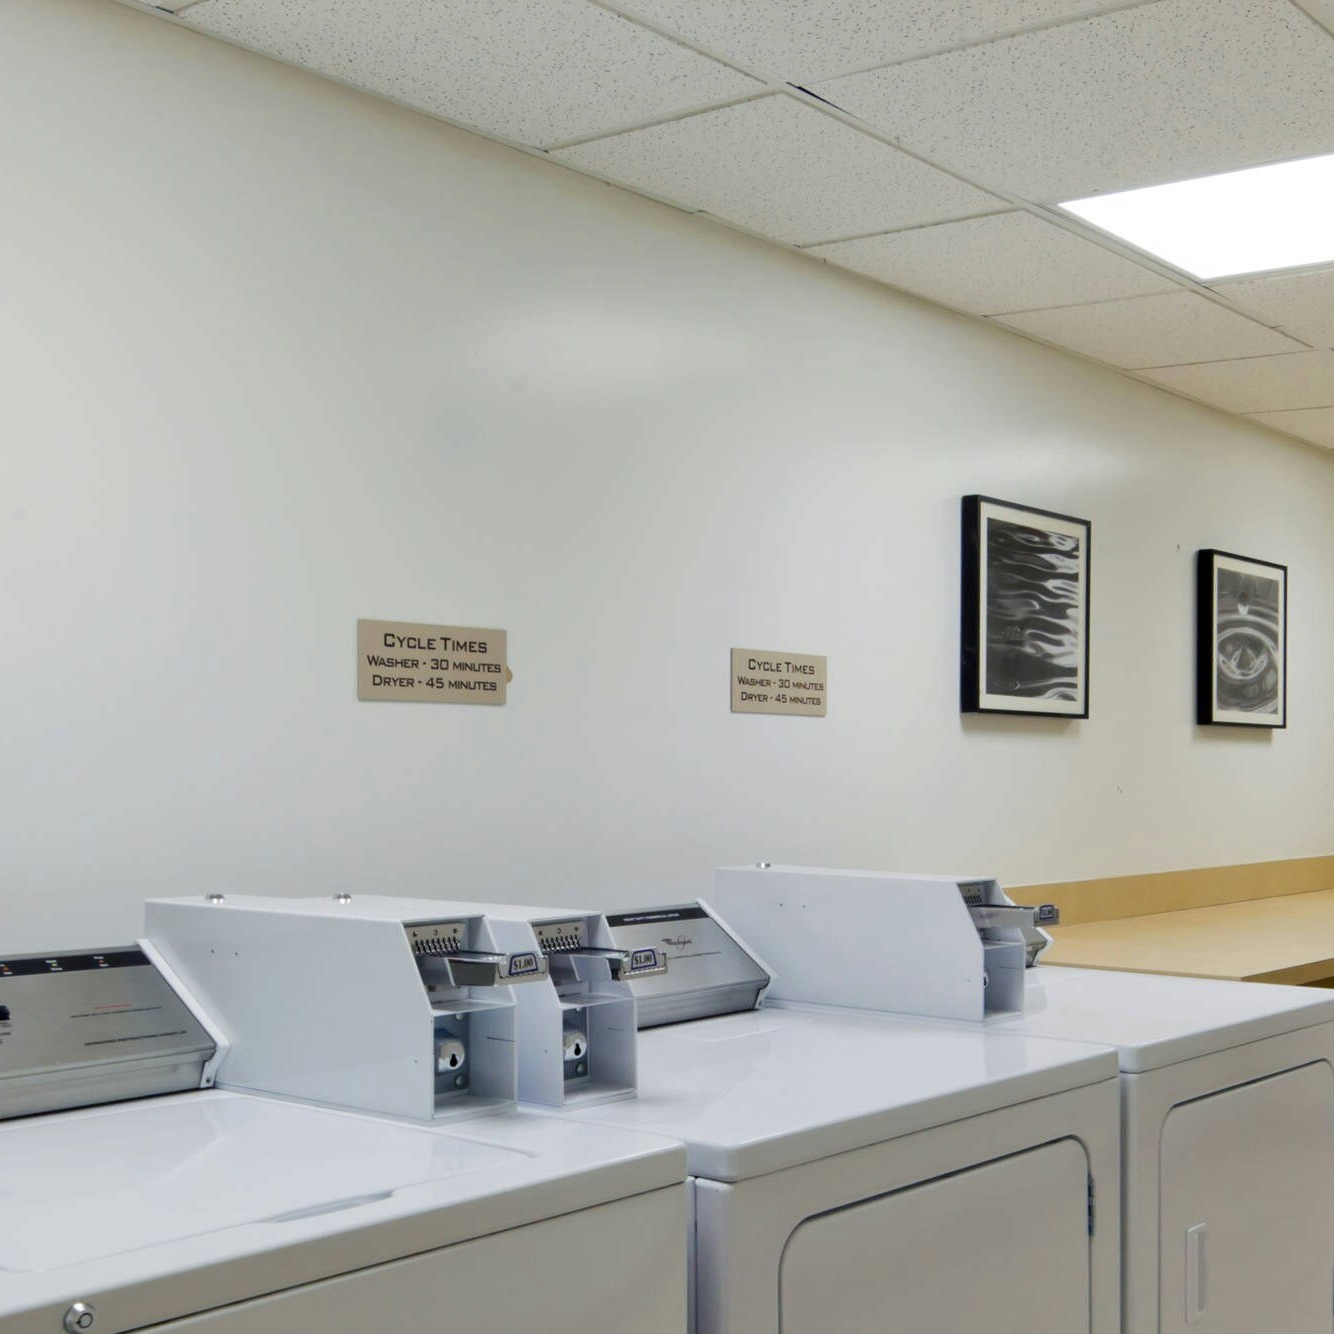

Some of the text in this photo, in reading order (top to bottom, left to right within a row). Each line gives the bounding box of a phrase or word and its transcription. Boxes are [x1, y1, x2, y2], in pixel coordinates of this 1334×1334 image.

[383, 633, 488, 654] CYCLE TIMES
[367, 654, 420, 669] WASHER
[430, 658, 449, 671] 30
[453, 662, 502, 674] MINUTES
[748, 658, 815, 675] CYCLE TIMES
[372, 674, 415, 689] DRYER
[425, 677, 445, 689] 45
[448, 680, 498, 692] MINUTES
[737, 675, 772, 688] WASHER
[778, 679, 791, 689] 30
[792, 681, 824, 691] MINUTES
[740, 691, 769, 703] DRYER
[775, 694, 788, 704] 45
[789, 696, 822, 706] MINUTES
[513, 957, 534, 971] $1.00
[634, 952, 653, 966] $1.00
